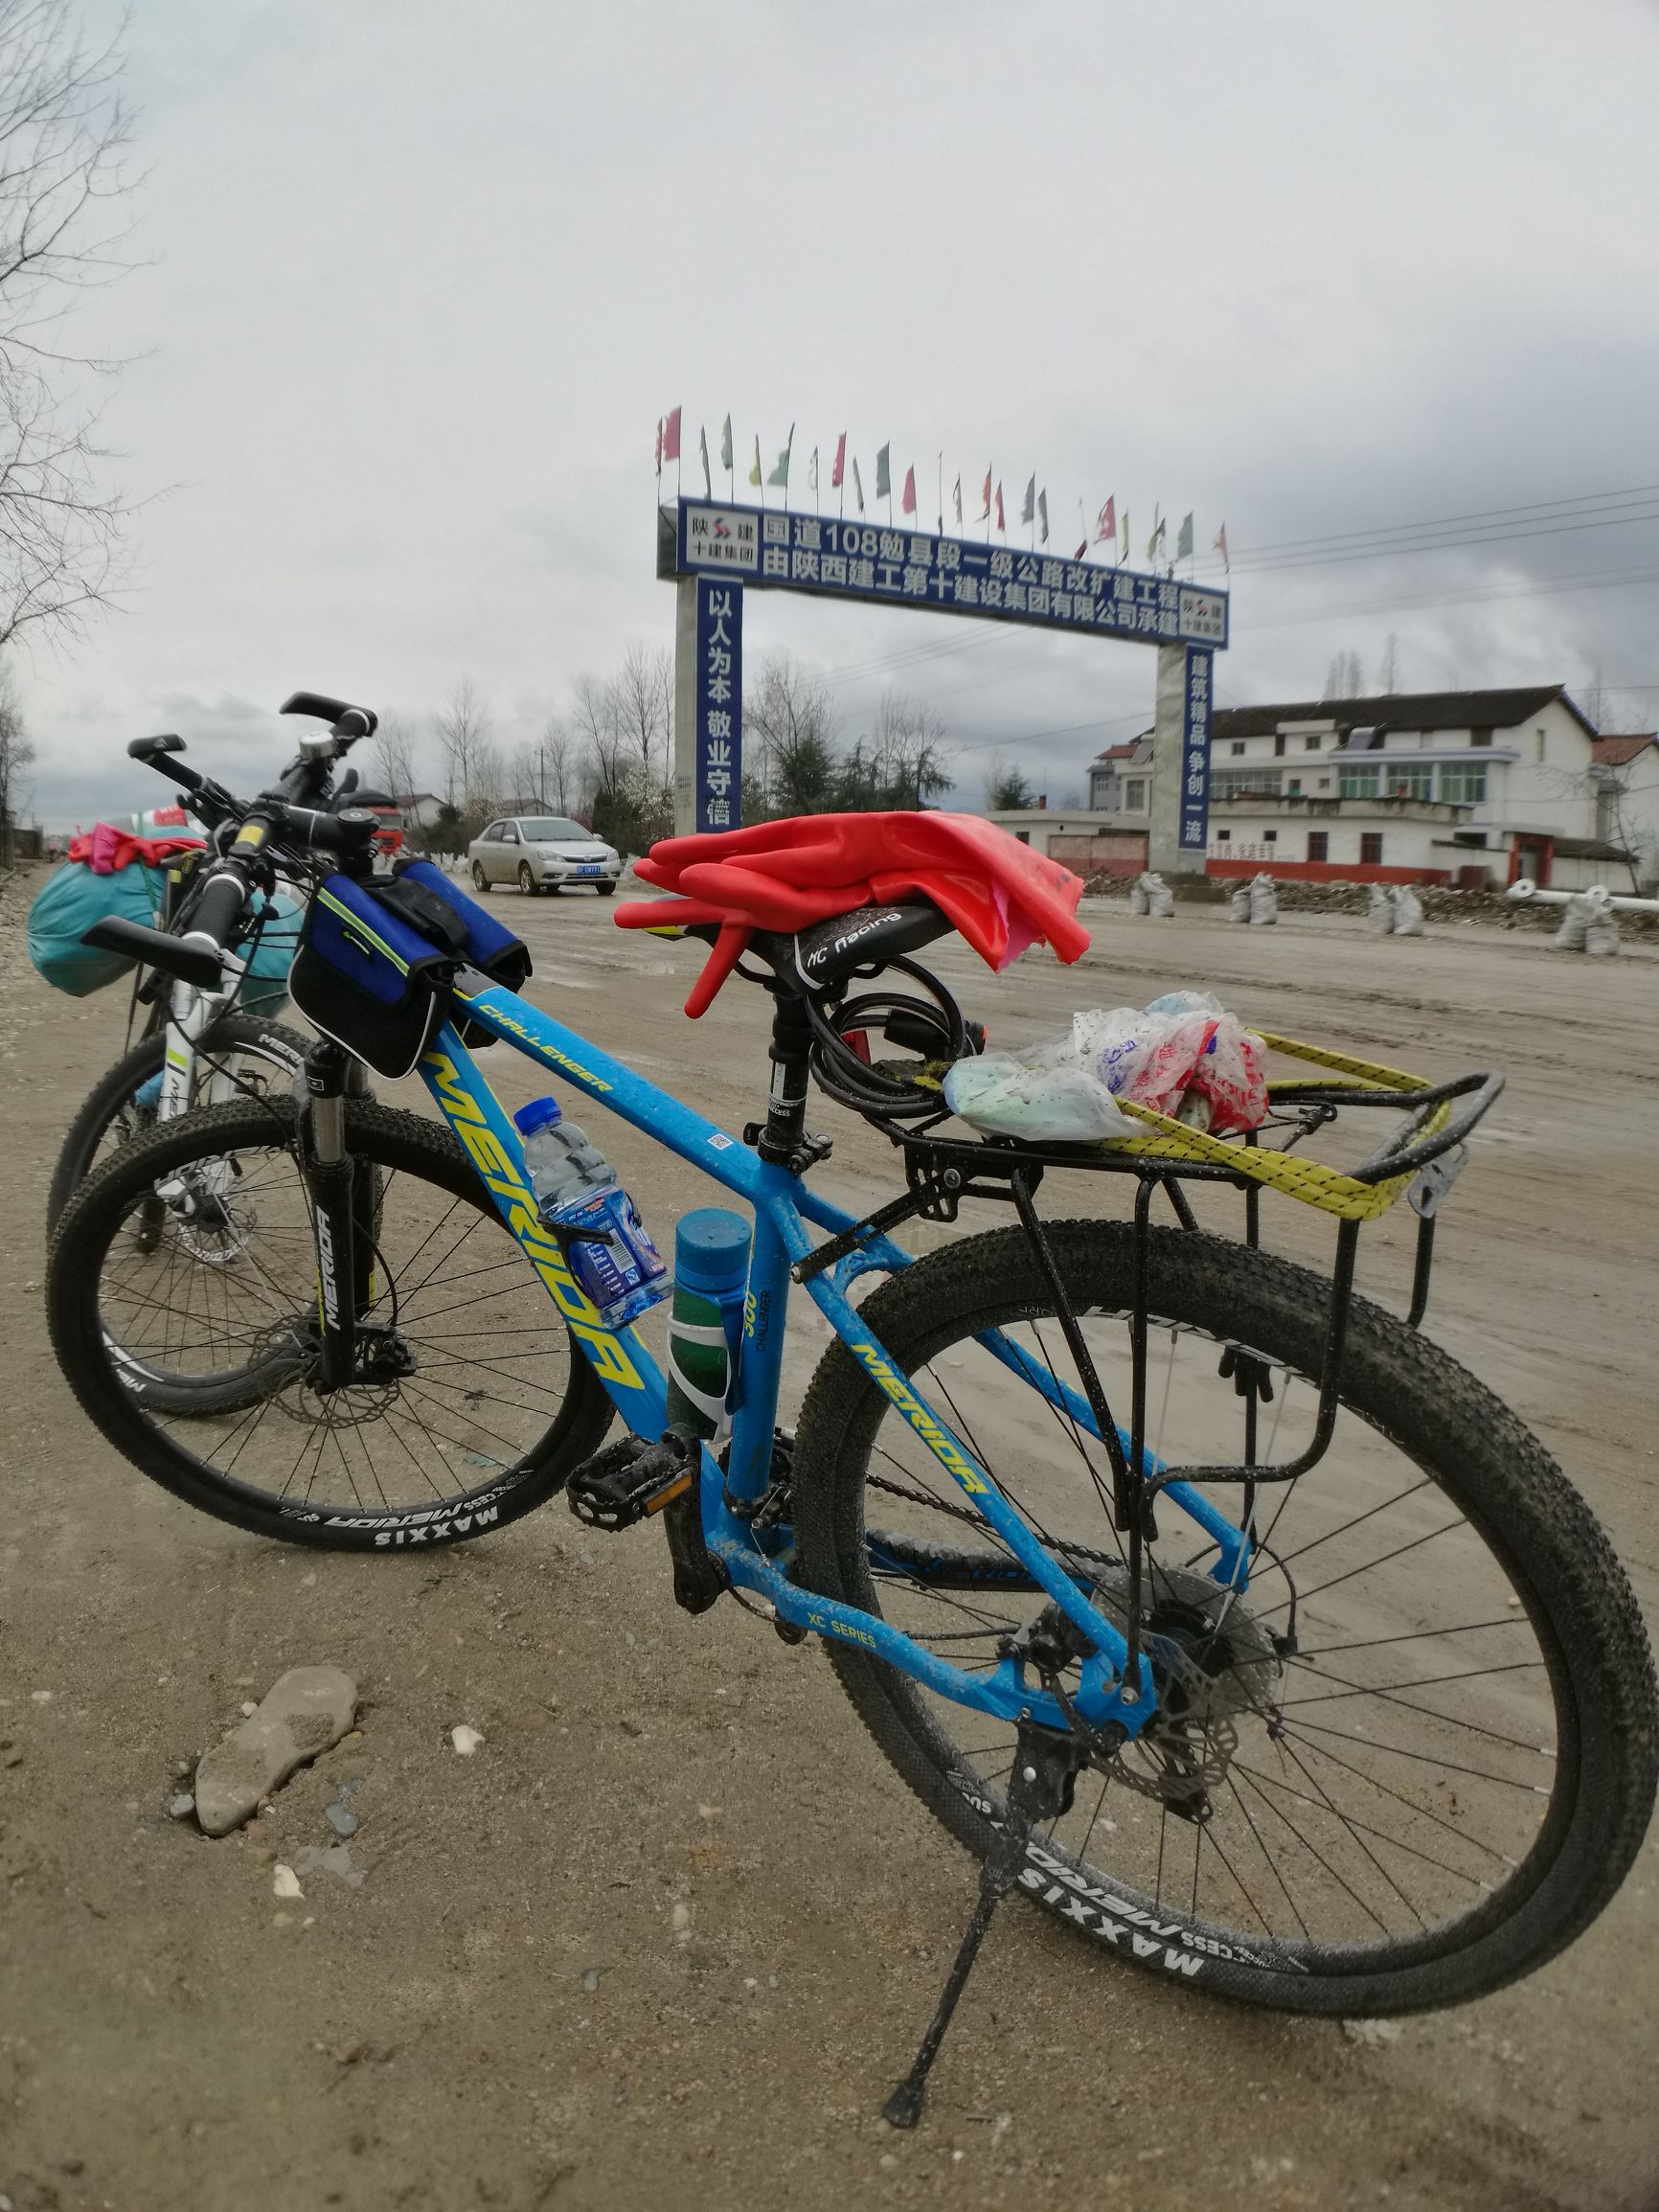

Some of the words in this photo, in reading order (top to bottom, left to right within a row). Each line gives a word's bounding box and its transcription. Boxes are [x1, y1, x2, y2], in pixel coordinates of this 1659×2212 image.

[693, 543, 754, 562] 十建集团
[707, 590, 732, 703] 以人为本
[834, 913, 902, 953] Racing
[479, 1004, 614, 1092] CHALLENGER
[424, 1053, 645, 1390] MERIDA
[316, 1204, 341, 1331] MERIDA
[851, 1344, 990, 1494] MERIDA
[324, 1502, 464, 1529] MERIDA
[375, 1505, 499, 1546] MAXXIS
[807, 1612, 826, 1628] XC
[830, 1620, 876, 1648] SERIES
[1017, 1868, 1205, 1976] MAXXIS
